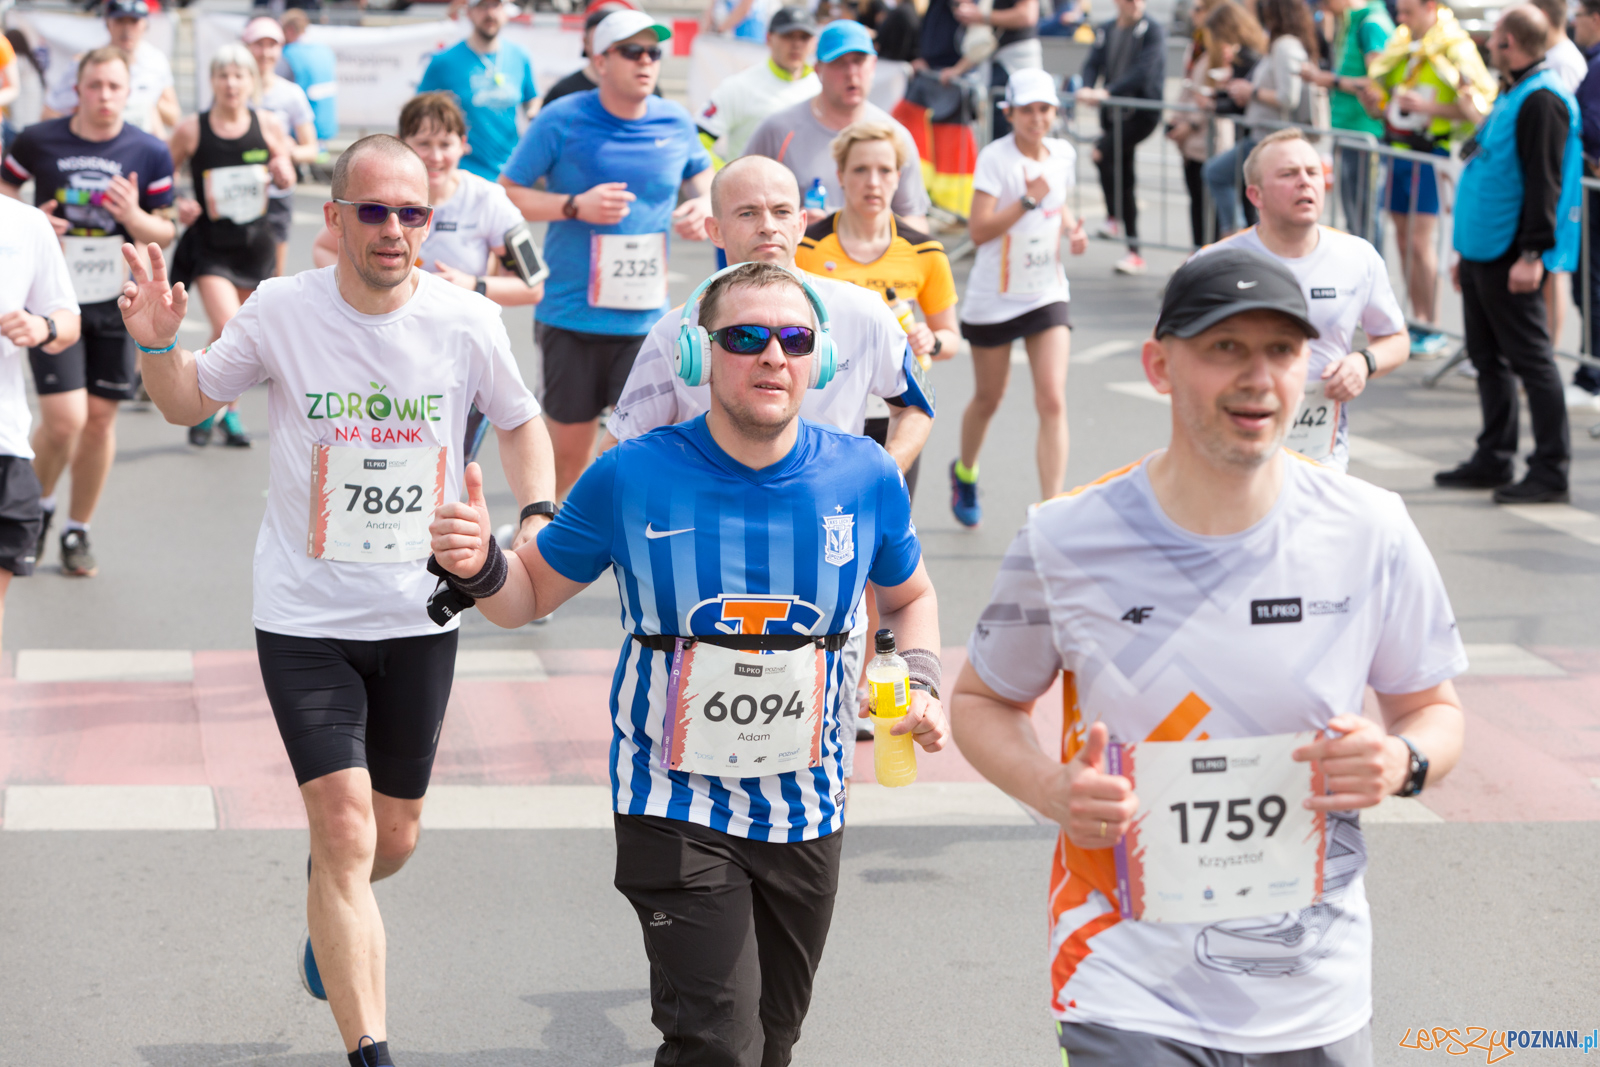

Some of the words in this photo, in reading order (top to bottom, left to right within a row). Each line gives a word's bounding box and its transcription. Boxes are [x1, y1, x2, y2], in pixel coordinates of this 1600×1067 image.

[74, 260, 114, 273] 9991
[613, 258, 657, 277] 2325
[305, 391, 443, 421] ZDROWIE
[335, 426, 362, 442] NA
[371, 427, 423, 443] BANK
[344, 483, 423, 515] 7862
[366, 521, 401, 531] Andrzej
[703, 690, 805, 726] 6094
[737, 732, 770, 742] Adam
[1170, 795, 1287, 844] 1759
[1198, 852, 1264, 868] Krzysztof
